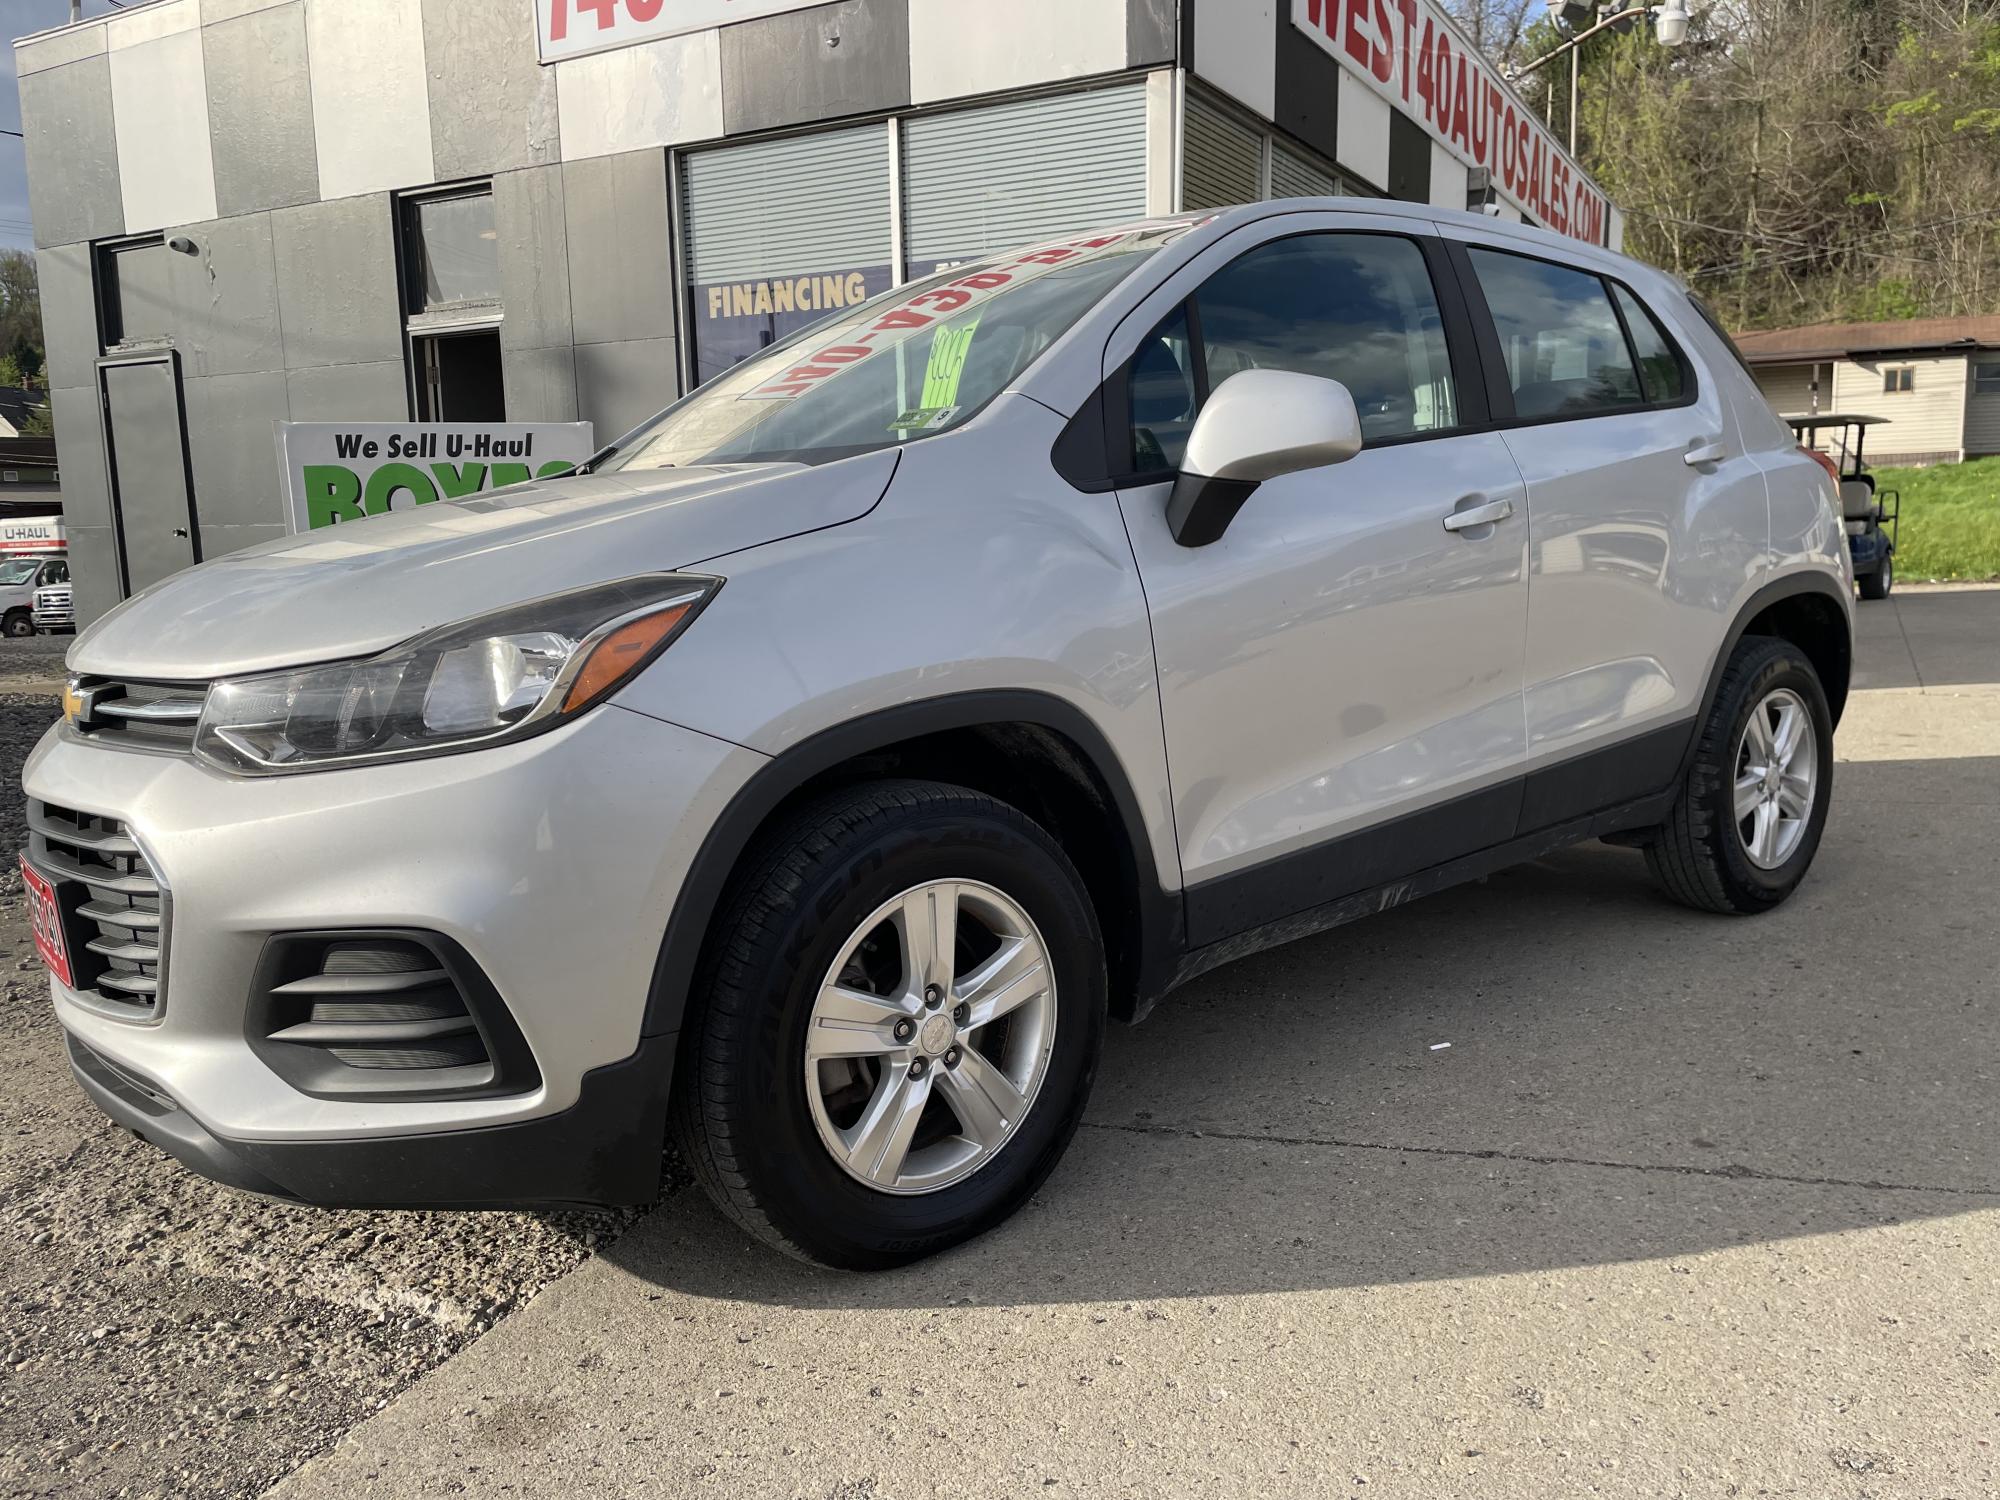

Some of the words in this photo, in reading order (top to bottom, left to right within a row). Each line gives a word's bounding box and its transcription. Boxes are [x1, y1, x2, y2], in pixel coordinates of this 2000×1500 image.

[708, 272, 866, 319] FINANCING
[335, 434, 378, 458] We
[388, 433, 437, 458] Sell
[446, 432, 533, 457] U-Haul
